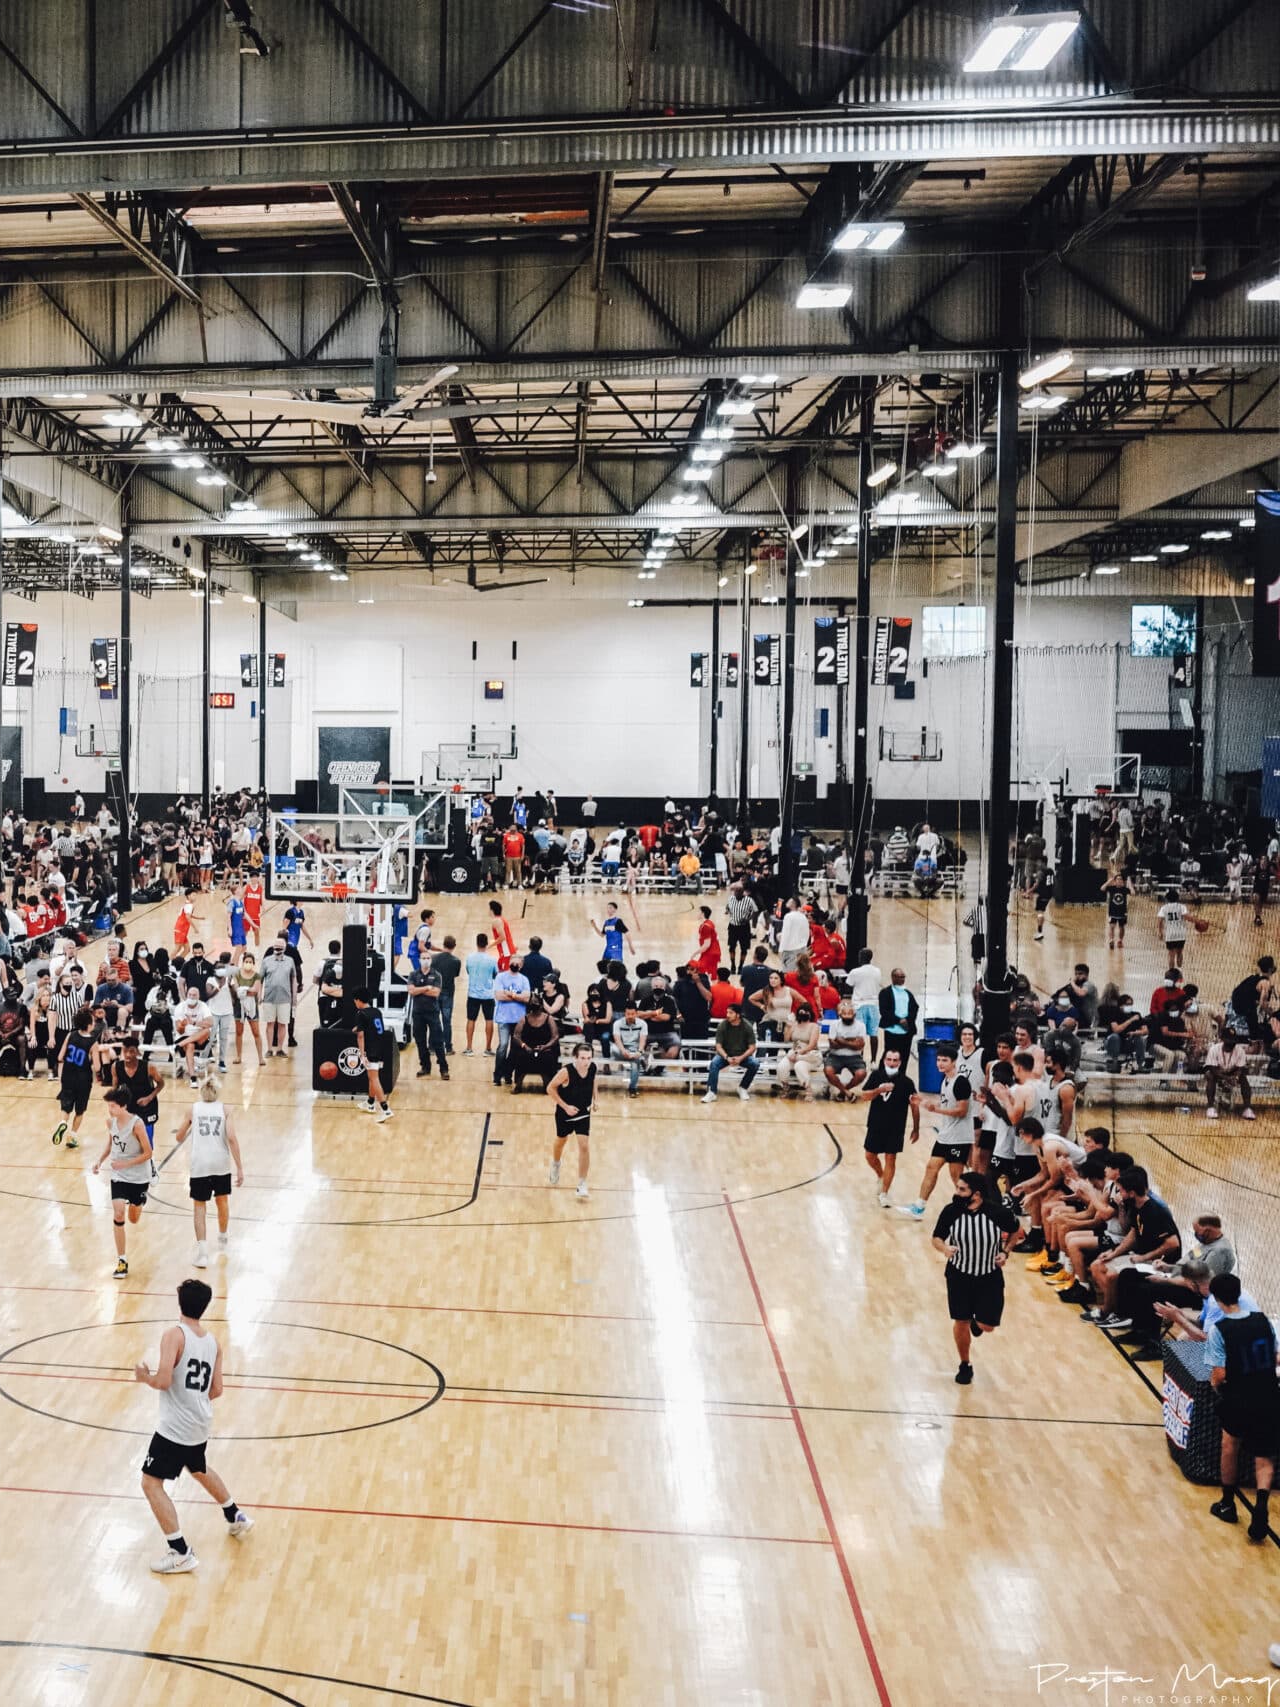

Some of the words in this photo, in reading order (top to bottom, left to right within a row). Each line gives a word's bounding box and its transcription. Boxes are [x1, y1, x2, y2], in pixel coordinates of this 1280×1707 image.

[5, 631, 18, 686] BASKETBALL
[19, 651, 34, 676] 2
[817, 647, 834, 673] 2
[837, 627, 848, 685] VOLLEYBALL
[874, 625, 889, 685] BASKETBALL
[889, 647, 907, 673] 2
[95, 658, 107, 678] 3
[242, 668, 251, 682] 4
[274, 667, 283, 682] 3
[692, 667, 701, 682] 4
[728, 667, 737, 682] 3
[755, 656, 769, 677] 3
[1174, 667, 1185, 681] 4
[375, 1018, 383, 1034] 9
[66, 1044, 86, 1066] 30
[198, 1119, 221, 1136] 57
[113, 1135, 126, 1153] CV
[185, 1358, 212, 1392] 23
